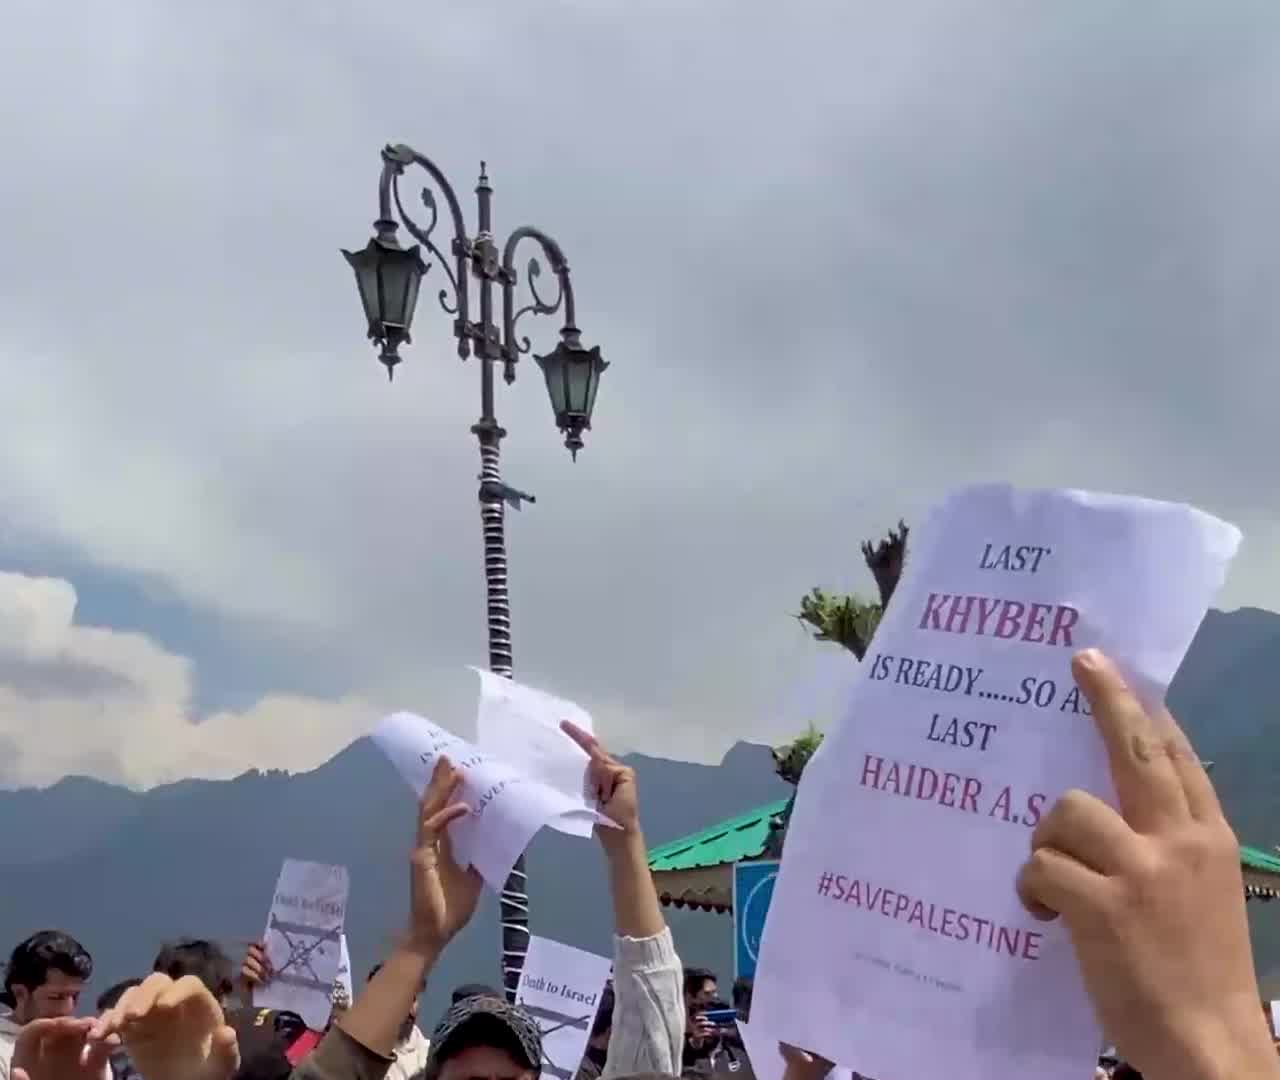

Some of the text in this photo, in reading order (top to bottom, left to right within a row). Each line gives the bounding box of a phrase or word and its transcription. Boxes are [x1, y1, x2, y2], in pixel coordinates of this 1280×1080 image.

[979, 543, 1052, 574] LAST
[918, 592, 1080, 648] KHYBER
[869, 653, 895, 682] IS
[927, 713, 998, 752] LAST
[859, 754, 984, 815] HAIDER
[818, 871, 1044, 961] #SAVEPALESTINE
[546, 982, 559, 994] to
[560, 984, 597, 1007] Israel
